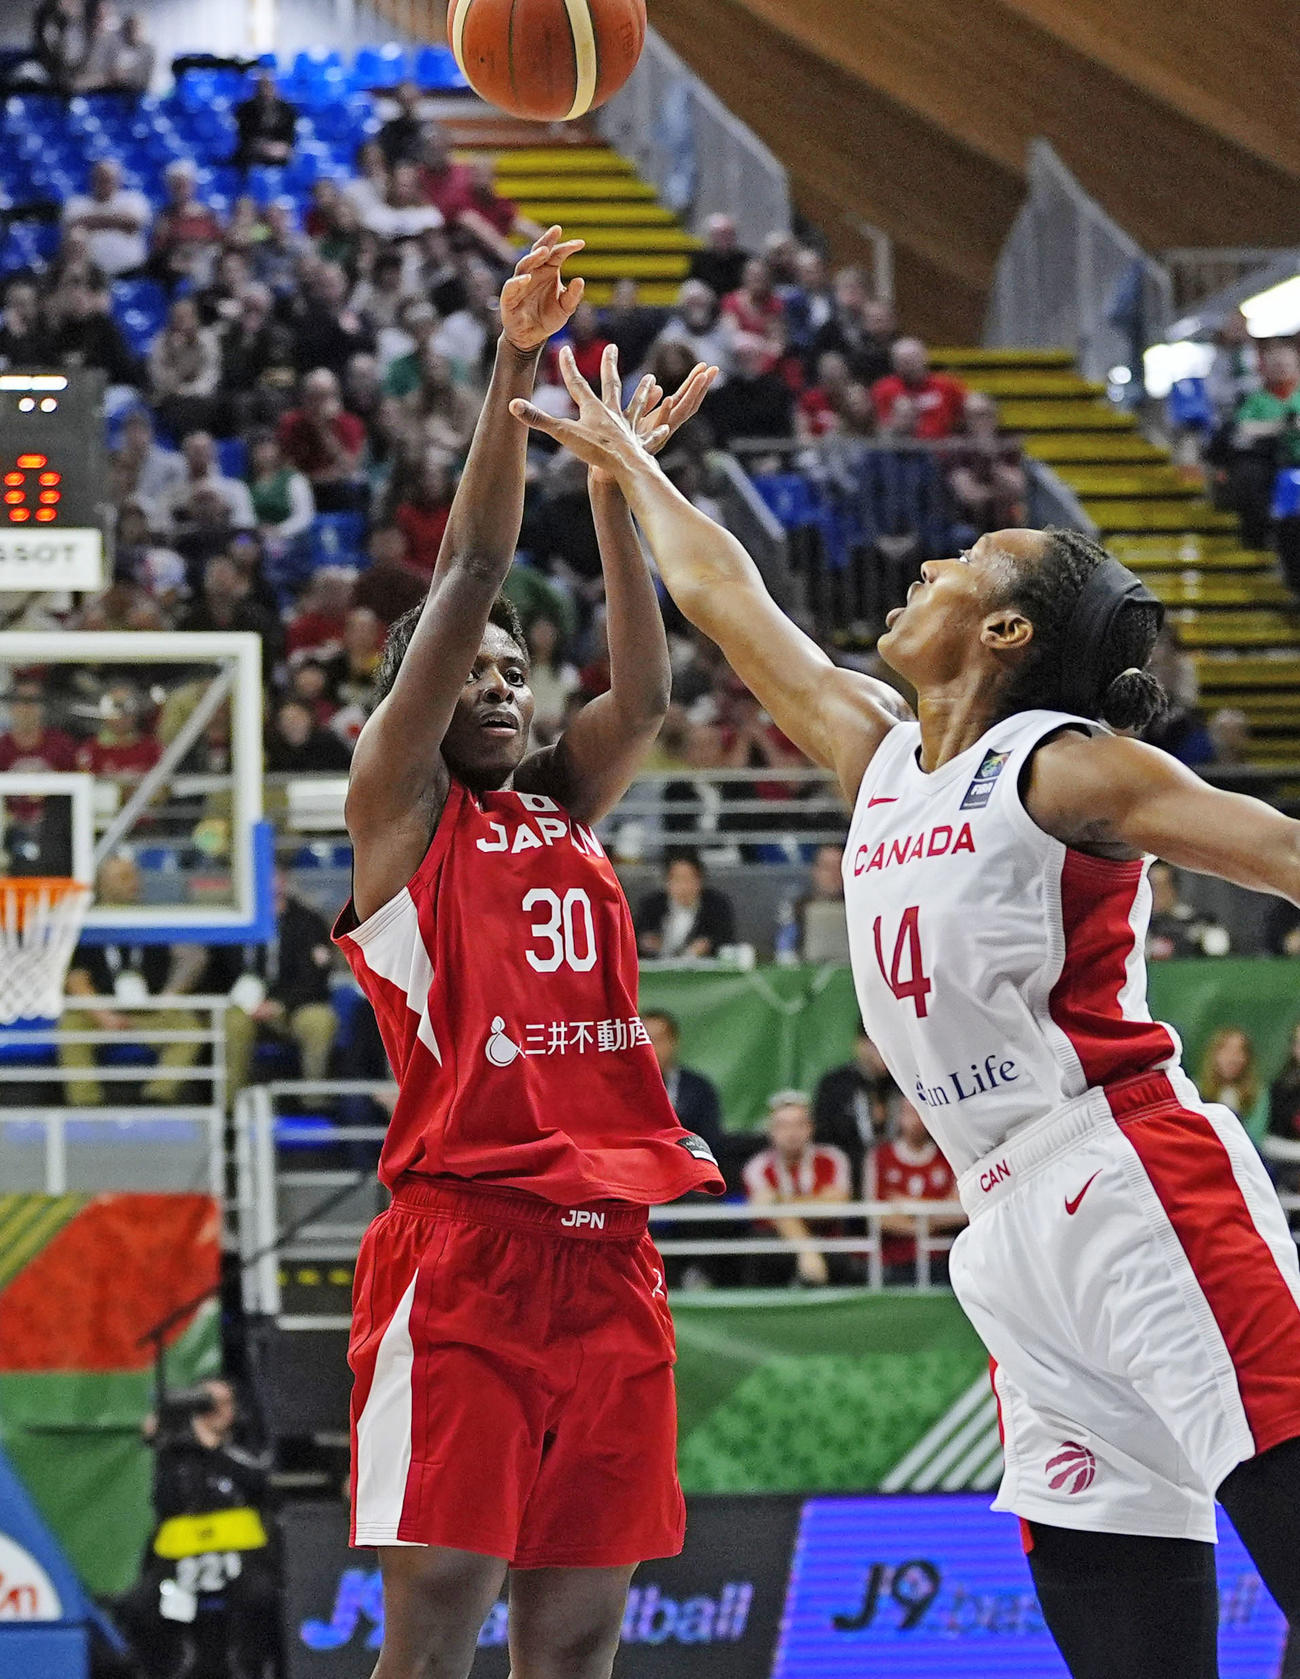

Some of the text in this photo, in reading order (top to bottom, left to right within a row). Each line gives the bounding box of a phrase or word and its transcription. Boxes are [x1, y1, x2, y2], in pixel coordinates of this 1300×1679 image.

[854, 822, 976, 877] CANADA
[522, 888, 598, 972] 30
[872, 905, 932, 1019] 14
[525, 1016, 652, 1056] 三井不動産
[948, 1054, 1021, 1102] Life
[979, 1159, 1012, 1193] CAN
[561, 1210, 605, 1230] JPN
[832, 1559, 941, 1632] J9
